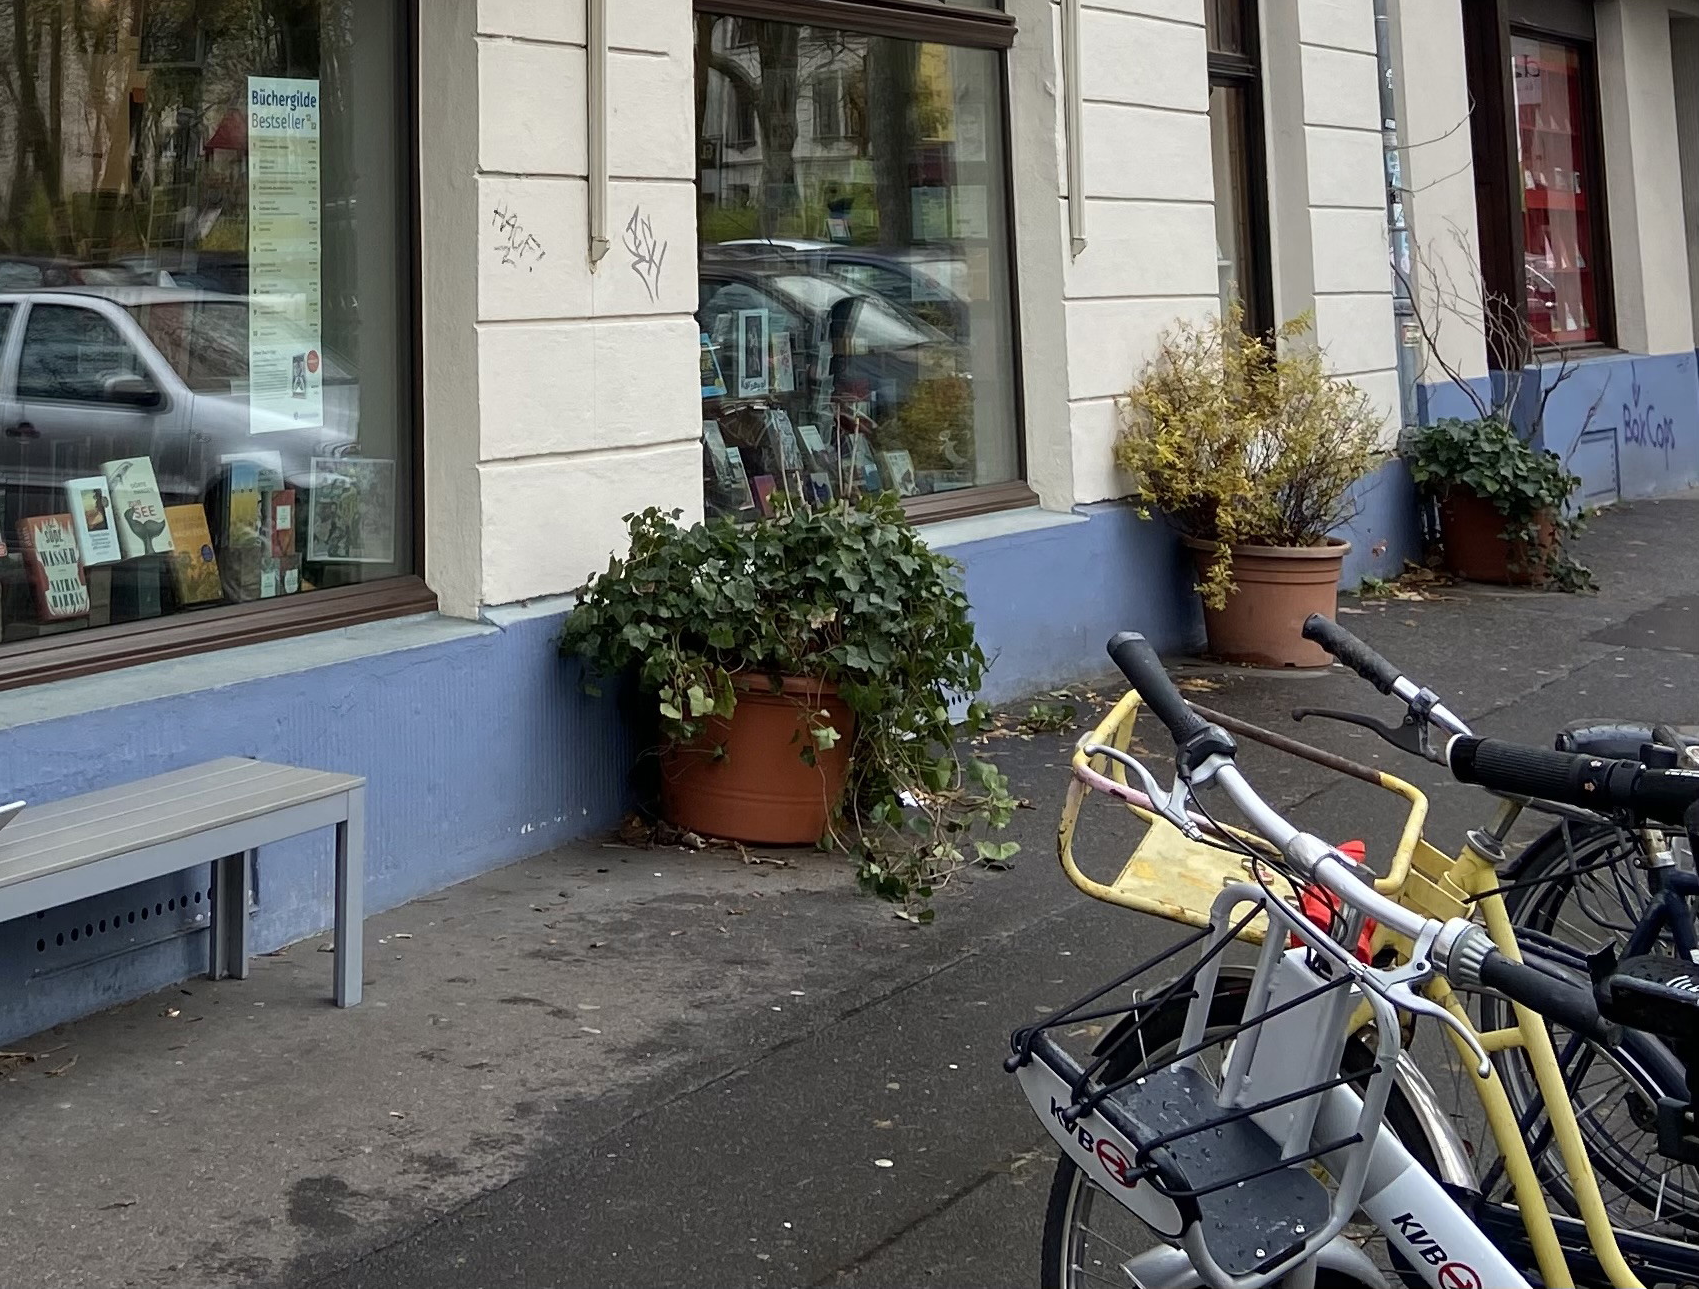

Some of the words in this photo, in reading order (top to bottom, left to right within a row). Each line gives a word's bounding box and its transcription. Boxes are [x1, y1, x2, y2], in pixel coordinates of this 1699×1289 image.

[252, 89, 317, 111] Büchergilde
[252, 112, 306, 130] Bestseller
[134, 505, 157, 519] SEE
[1391, 1212, 1448, 1266] KVB
